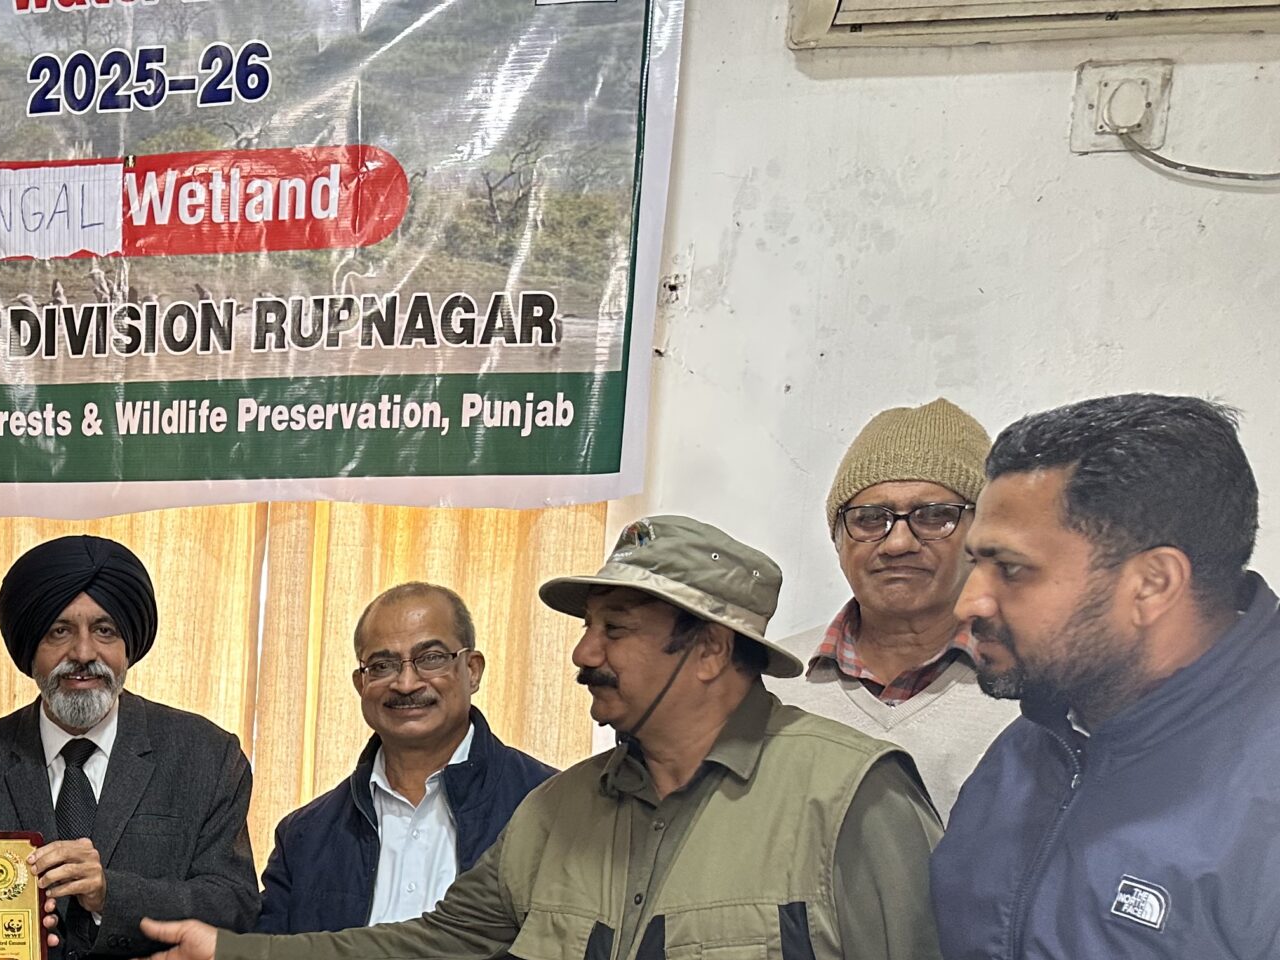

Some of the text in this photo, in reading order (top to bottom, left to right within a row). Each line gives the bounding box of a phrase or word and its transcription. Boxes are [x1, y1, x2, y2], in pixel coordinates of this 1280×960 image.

[28, 40, 271, 115] 2025-26
[124, 163, 341, 227] Wetland
[8, 298, 236, 360] DIVISION
[251, 291, 558, 353] RUPNAGAR
[81, 402, 104, 437] &
[115, 400, 228, 436] Wildlife
[237, 394, 450, 436] Preservation,
[461, 392, 575, 437] Punjab
